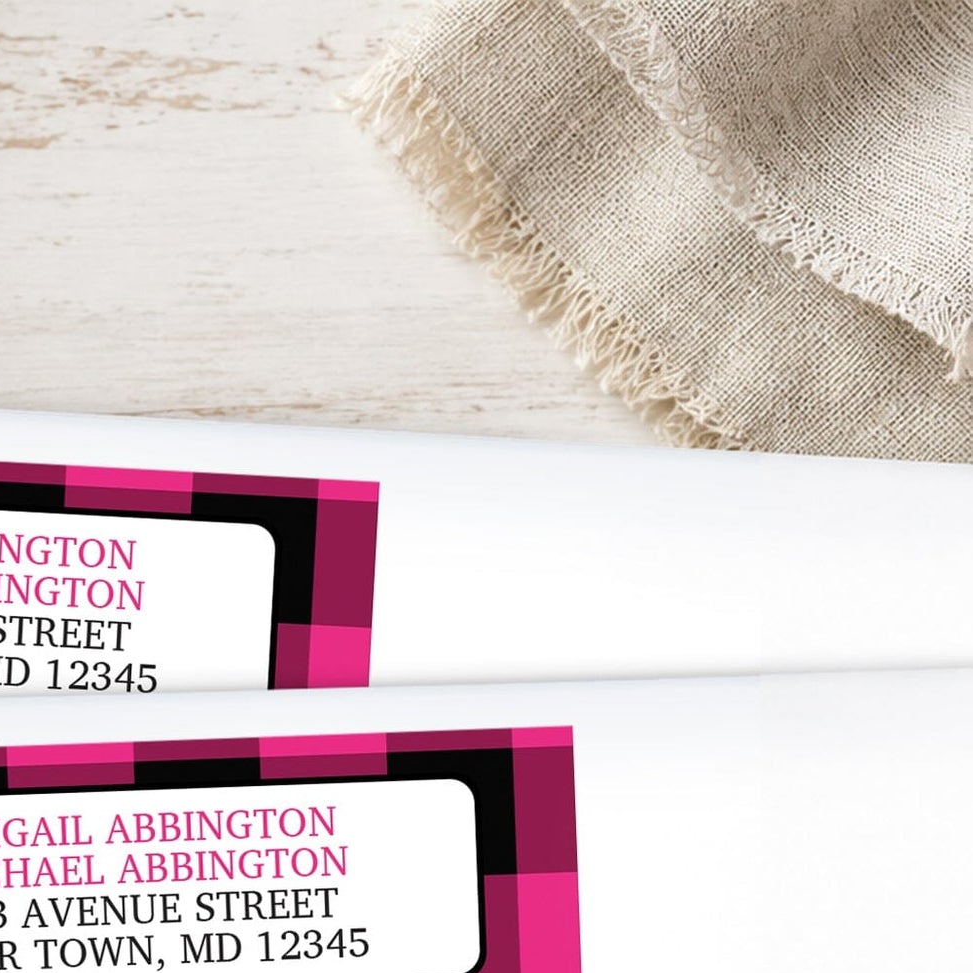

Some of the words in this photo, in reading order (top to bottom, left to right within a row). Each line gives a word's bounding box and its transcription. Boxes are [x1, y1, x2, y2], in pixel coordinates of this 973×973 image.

[46, 660, 157, 693] 12345
[106, 807, 336, 845] ABBINGTON
[118, 847, 348, 884] ABBINGTON
[22, 894, 182, 928] AVENUE
[196, 888, 338, 922] STREET
[34, 936, 164, 971] TOWN,
[181, 934, 242, 964] MD
[258, 928, 369, 962] 12345
